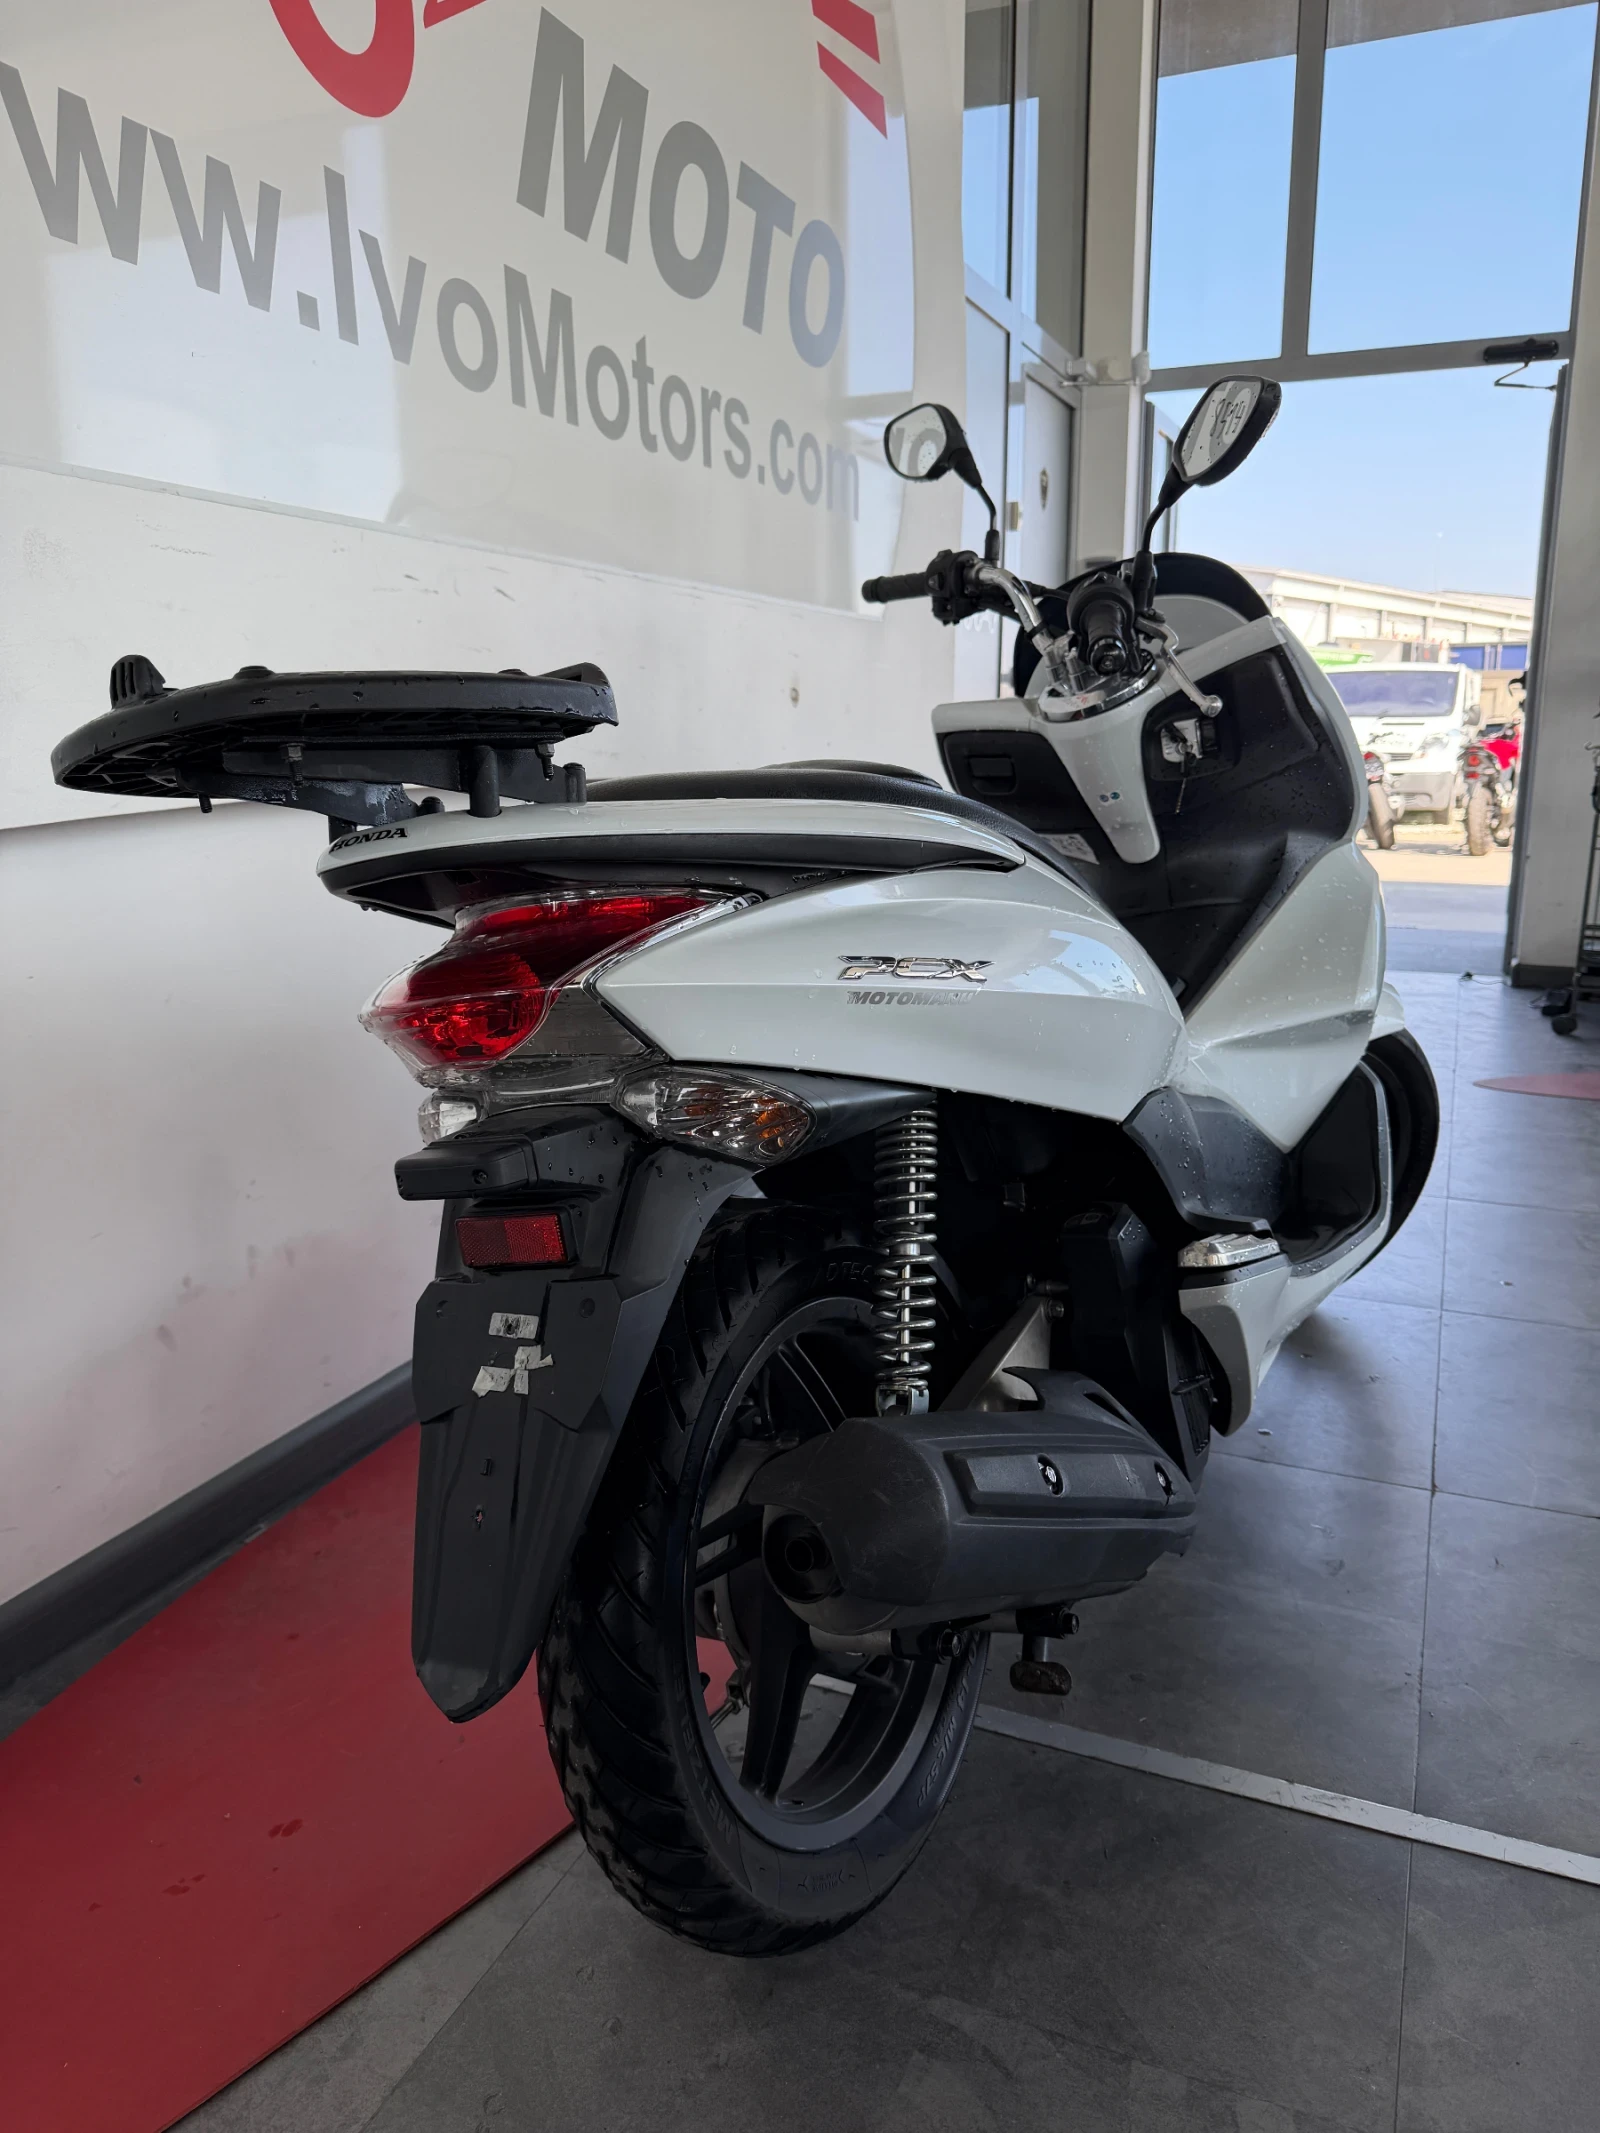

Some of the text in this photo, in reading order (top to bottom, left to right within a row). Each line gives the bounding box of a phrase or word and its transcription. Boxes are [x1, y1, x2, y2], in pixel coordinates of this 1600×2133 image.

[516, 6, 845, 368] MOTO
[328, 827, 408, 854] HONDA
[838, 955, 996, 982] PCX
